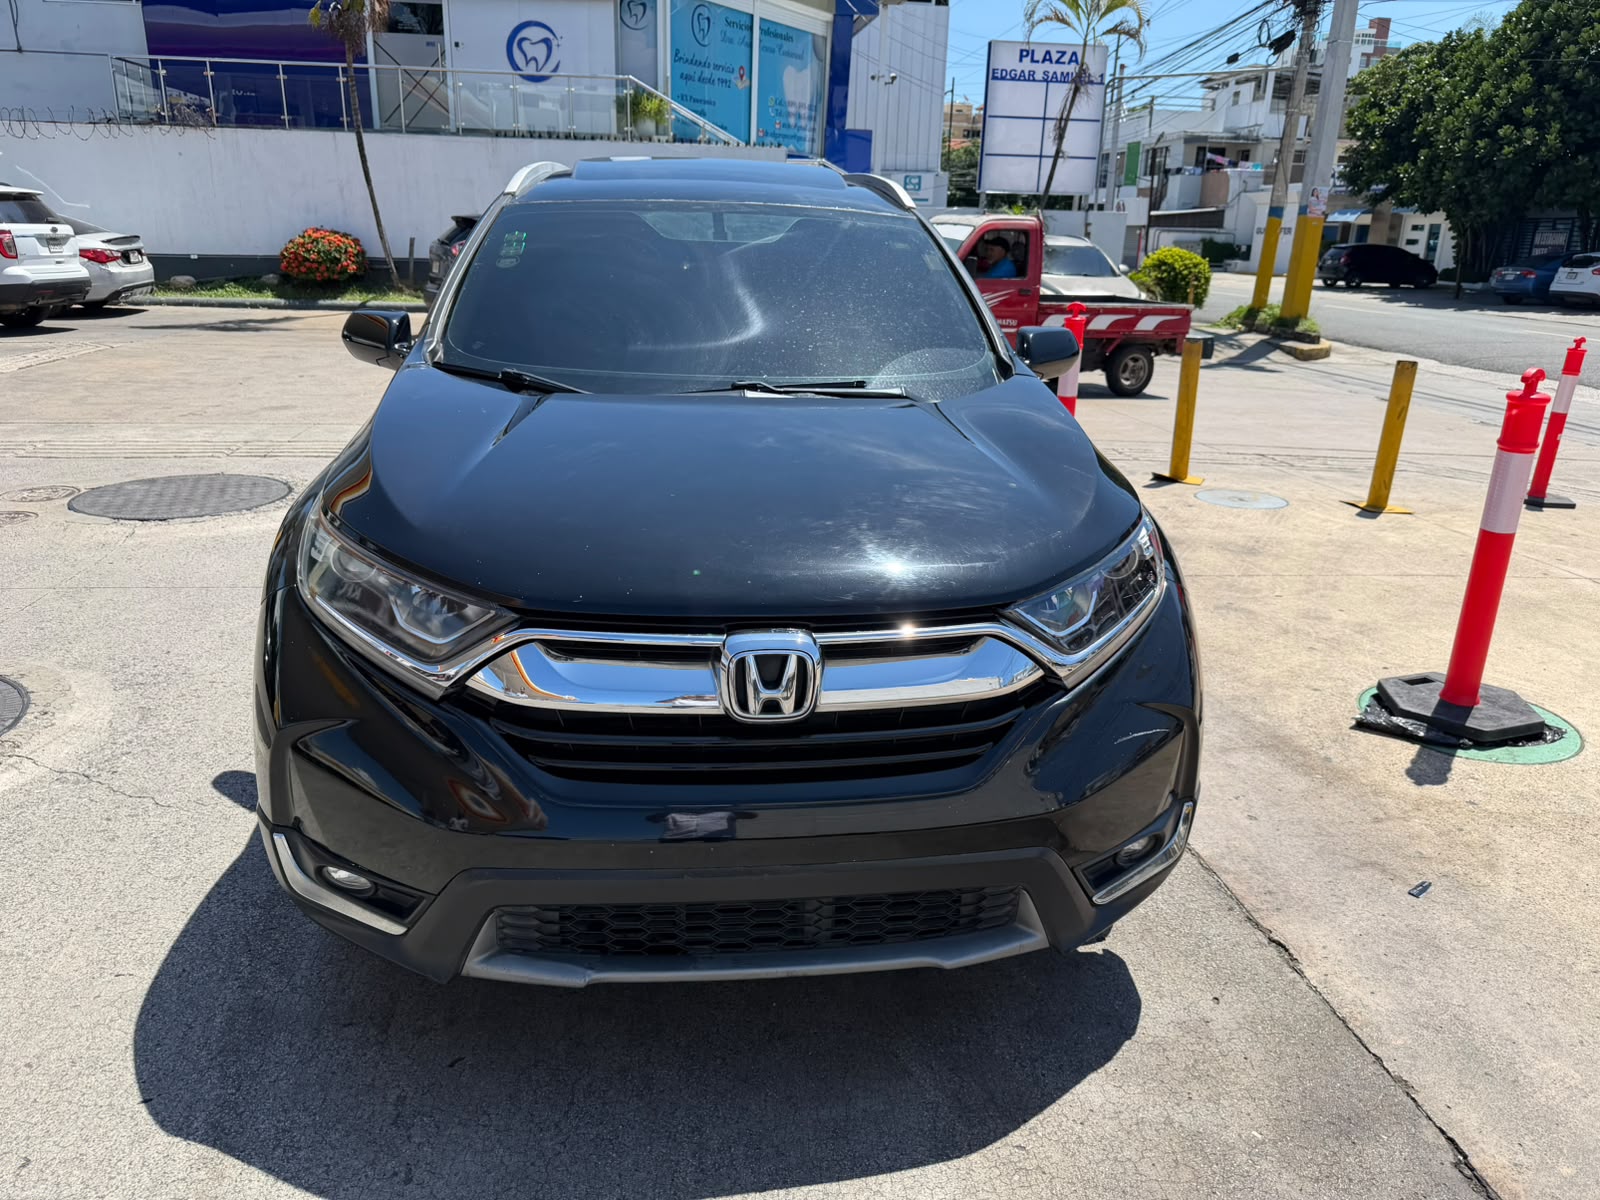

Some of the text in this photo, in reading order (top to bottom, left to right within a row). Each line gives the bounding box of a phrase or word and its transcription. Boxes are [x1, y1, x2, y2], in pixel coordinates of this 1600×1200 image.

[724, 16, 752, 33] Servicio
[759, 26, 794, 43] rofesionales
[673, 48, 711, 69] Brindando
[1018, 49, 1080, 65] PLAZA
[697, 70, 715, 86] desde
[717, 77, 732, 89] 1992
[991, 68, 1036, 81] EDGAR
[1042, 70, 1094, 85] SAML
[996, 318, 1018, 327] HATSU
